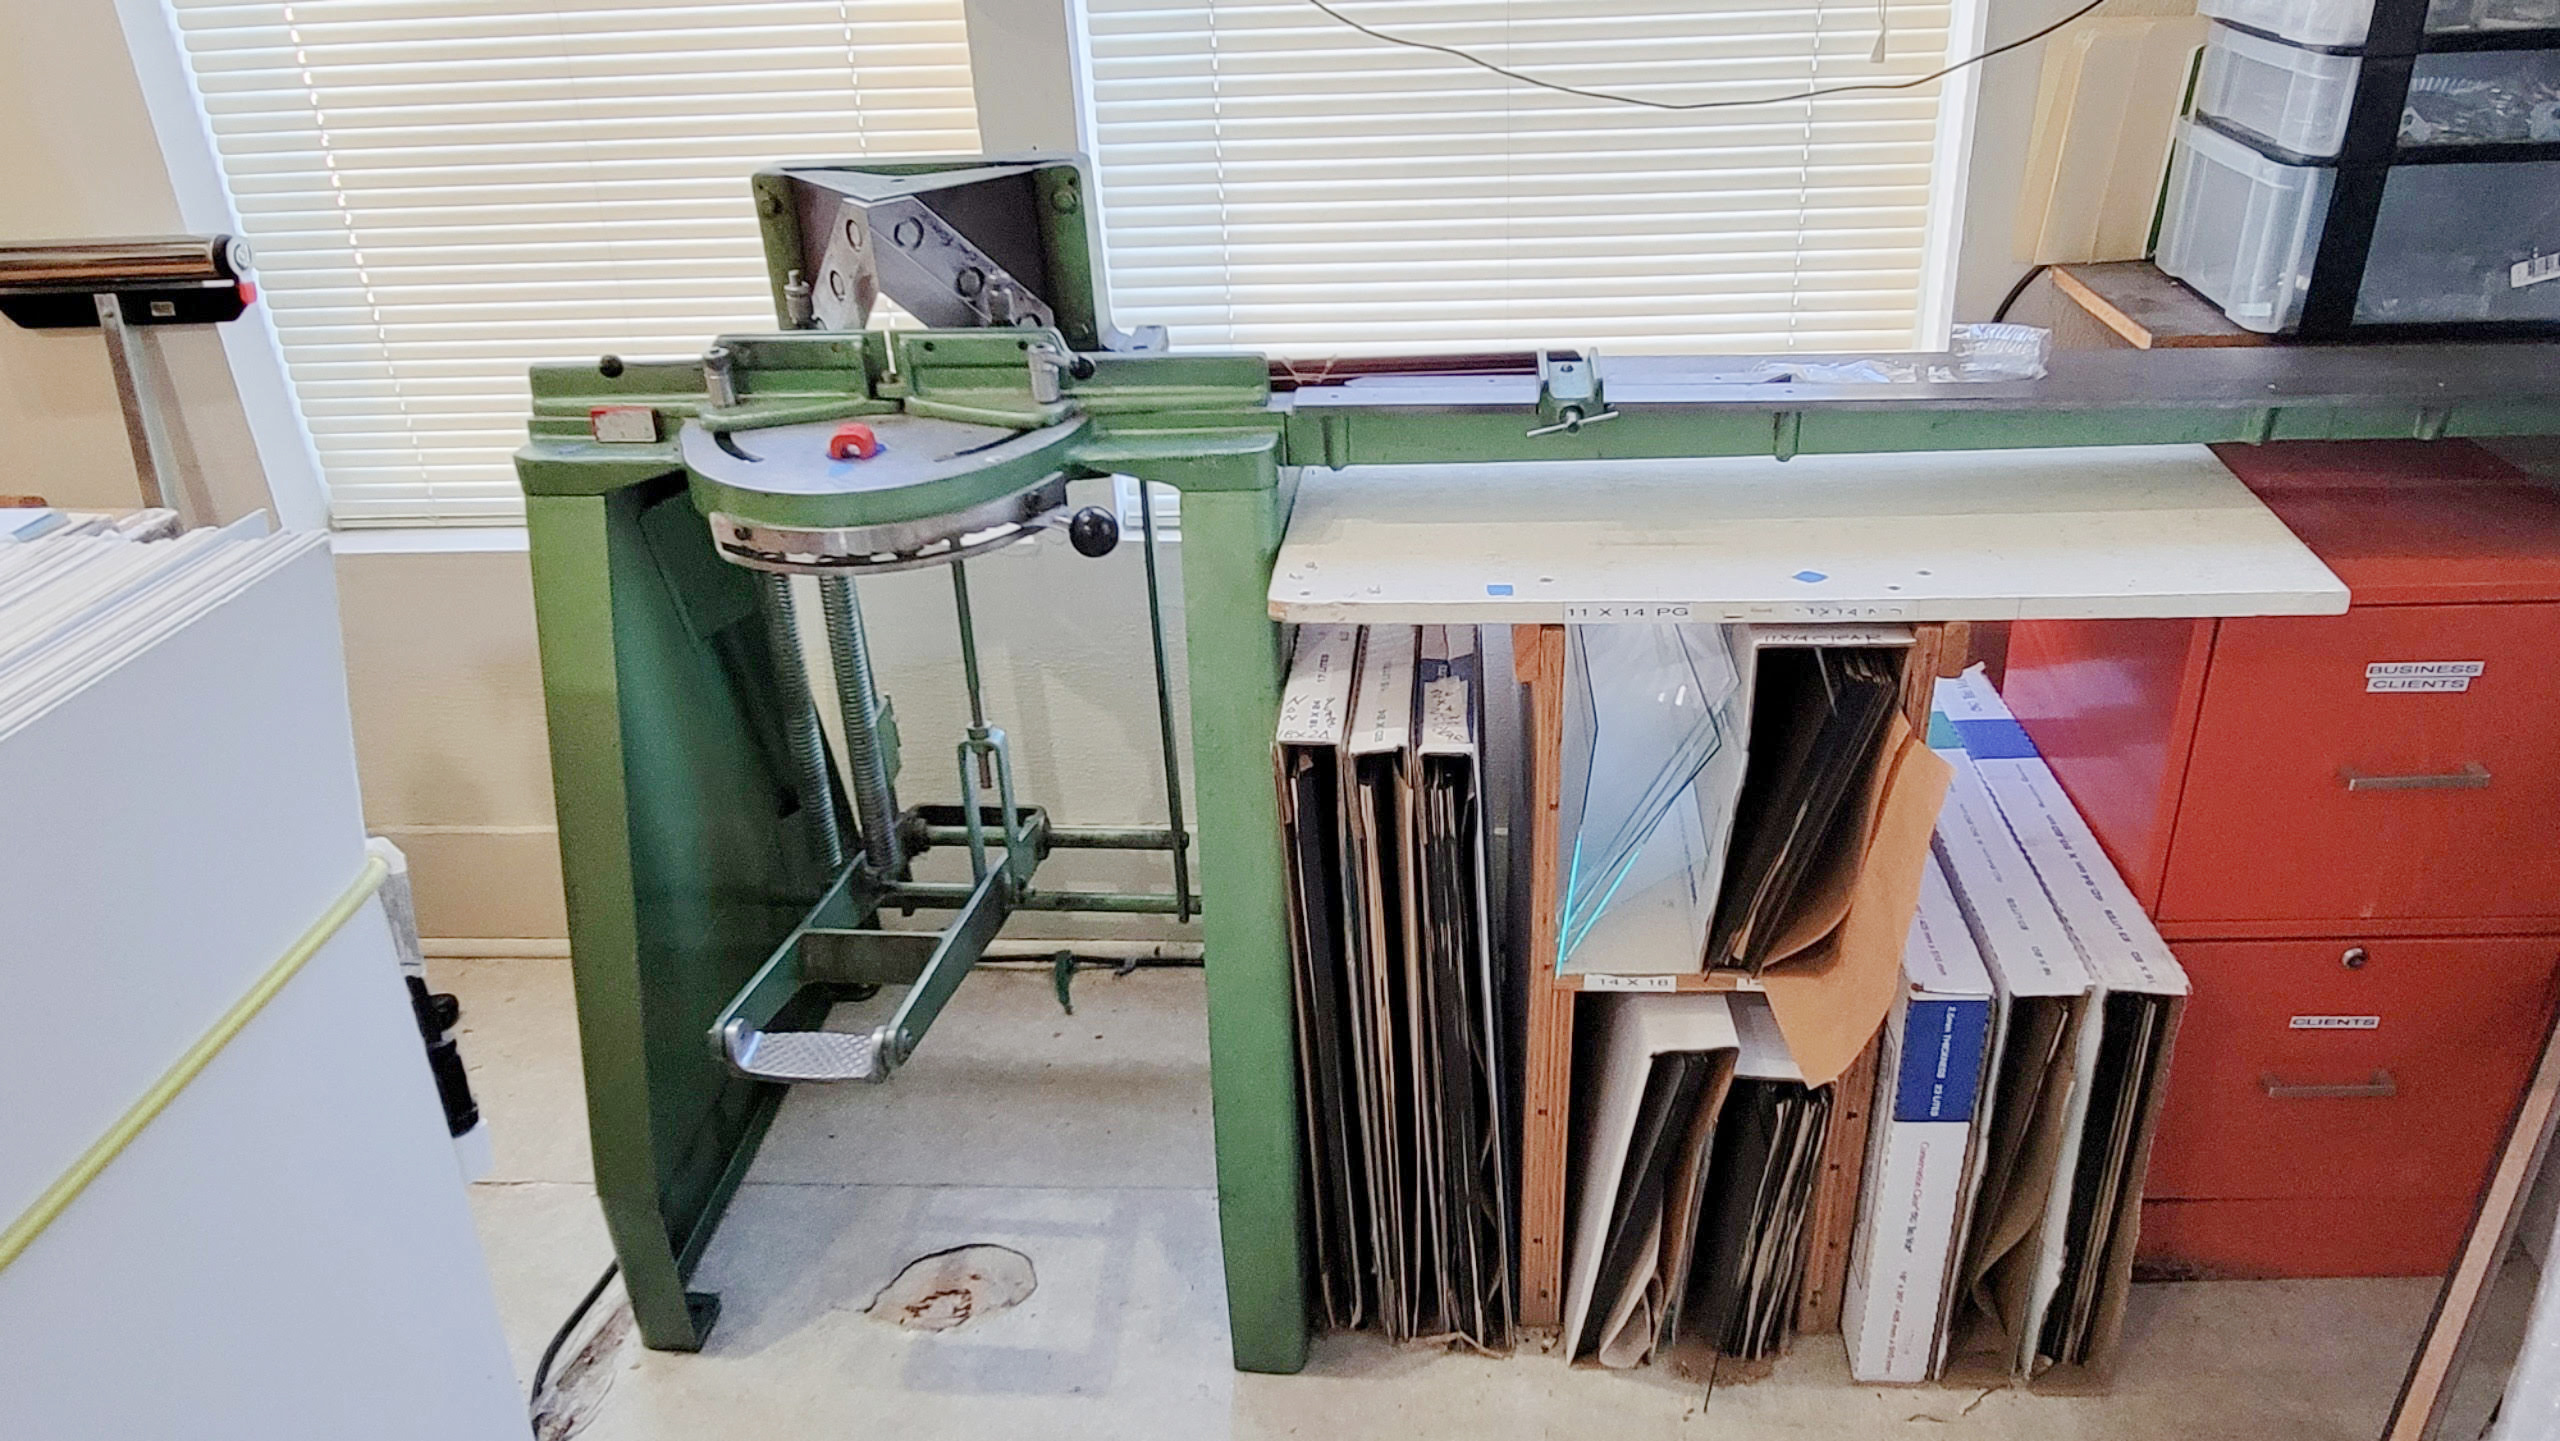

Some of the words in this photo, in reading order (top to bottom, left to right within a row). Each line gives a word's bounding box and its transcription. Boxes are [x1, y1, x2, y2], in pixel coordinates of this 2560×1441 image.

[1568, 607, 1589, 617] 11
[1599, 607, 1613, 617] X
[1622, 607, 1645, 617] 14
[1657, 606, 1690, 617] PG
[2369, 664, 2480, 675] BUSINESS
[2372, 679, 2466, 689] CLIENTS
[1627, 978, 1639, 987] X
[2292, 1018, 2376, 1026] CLIENTS
